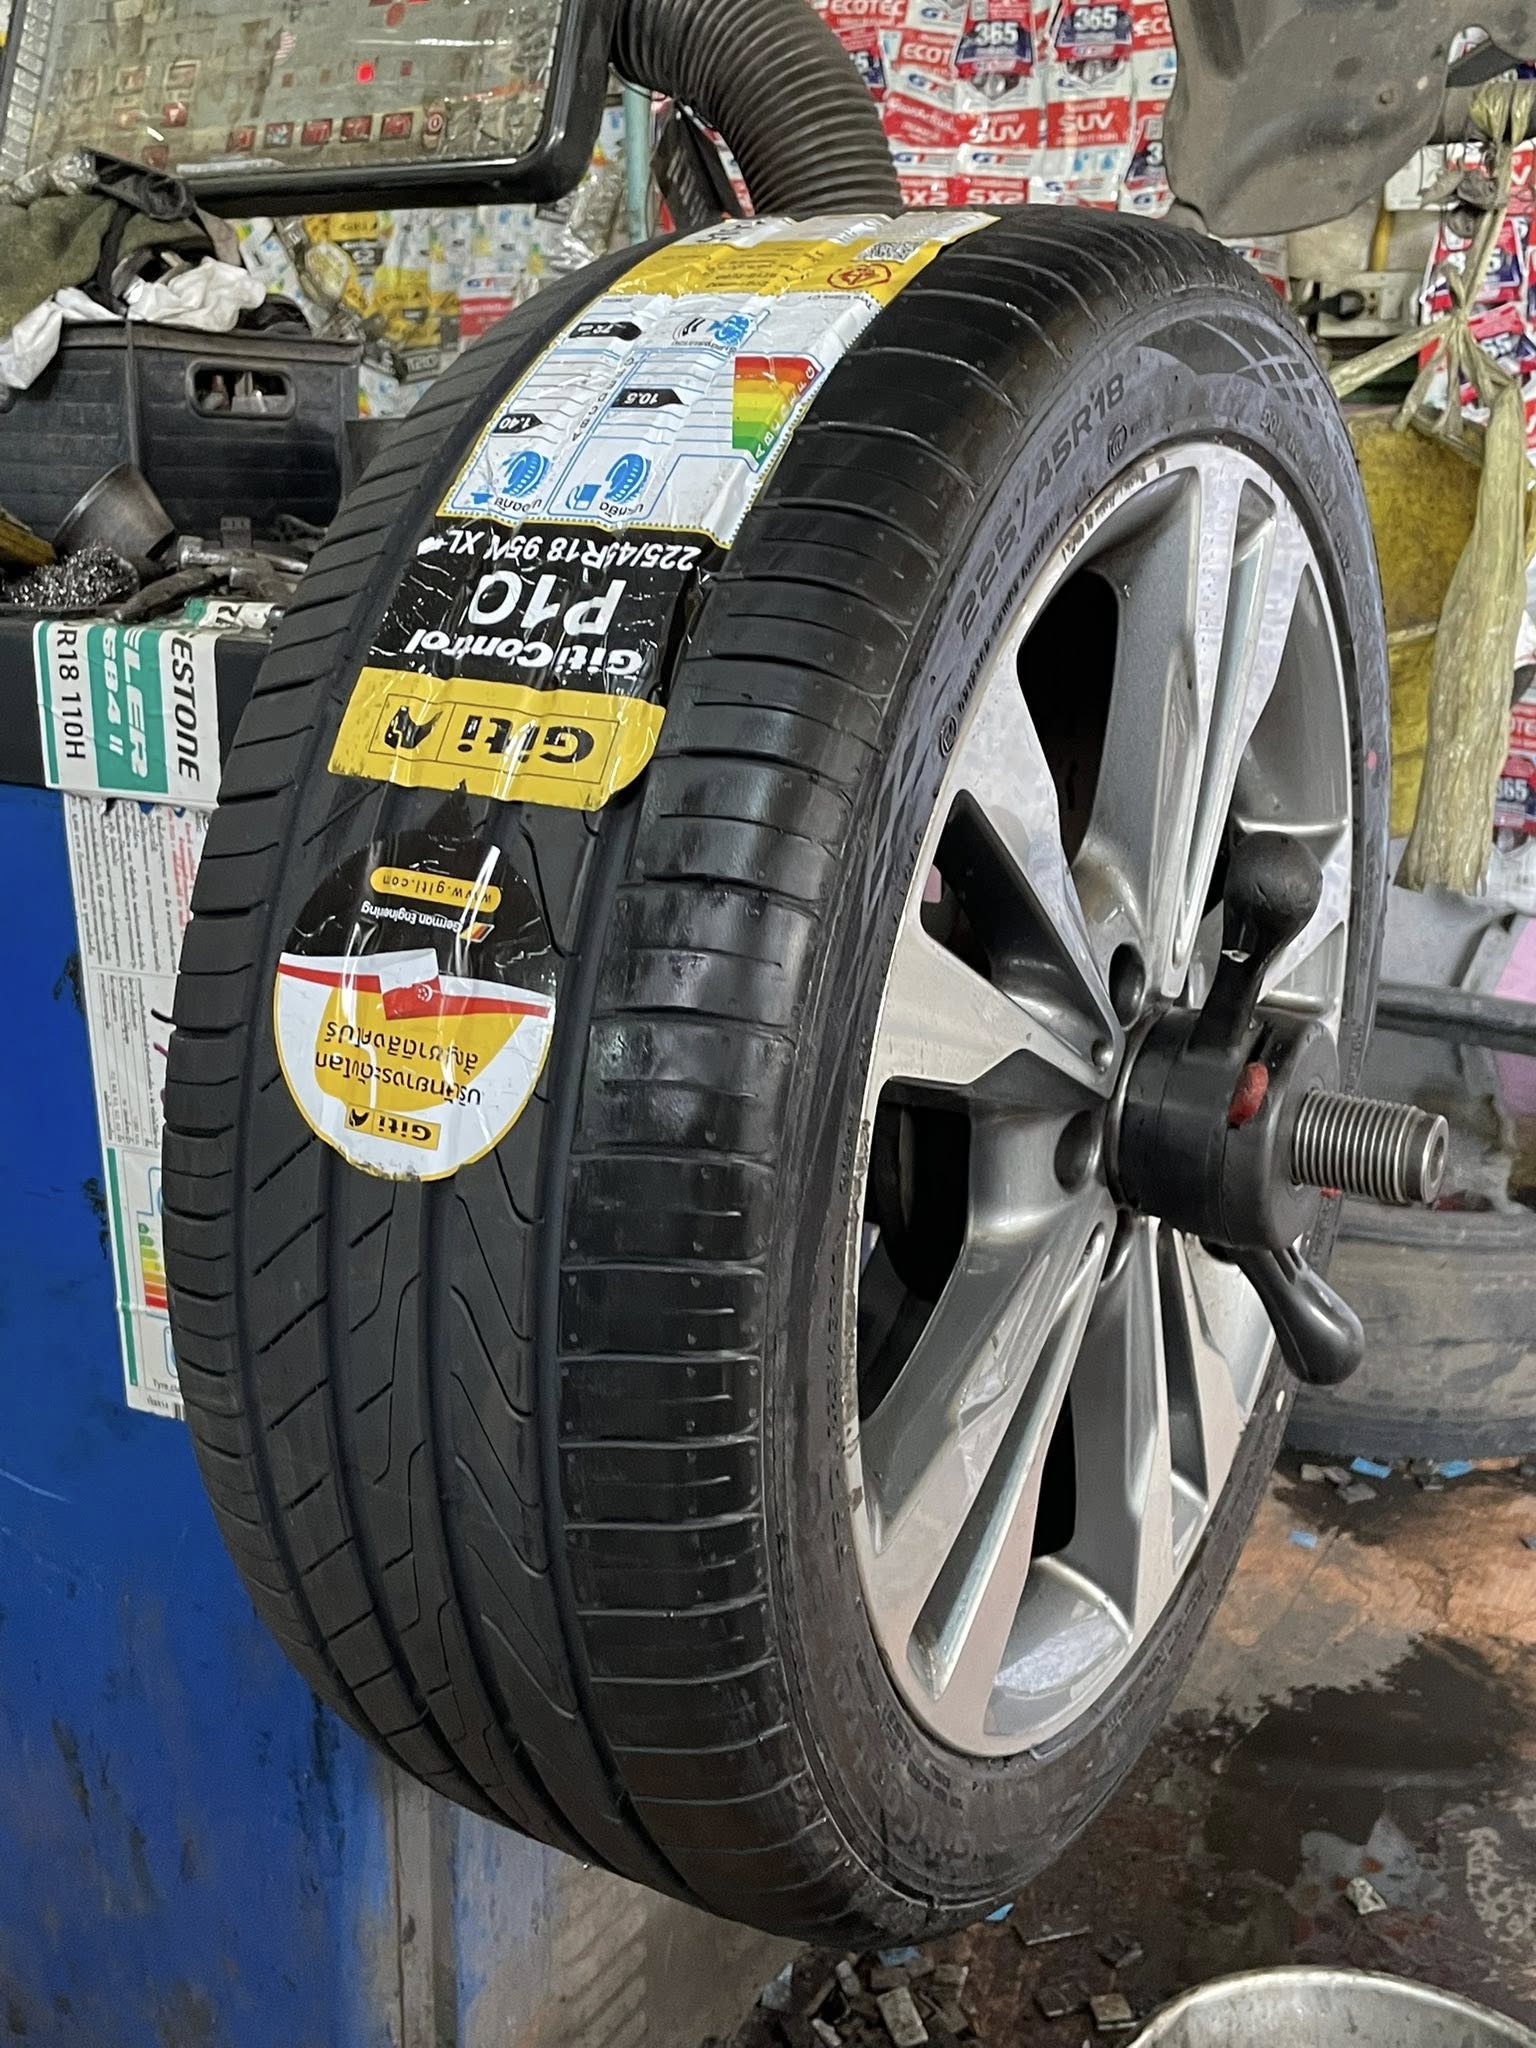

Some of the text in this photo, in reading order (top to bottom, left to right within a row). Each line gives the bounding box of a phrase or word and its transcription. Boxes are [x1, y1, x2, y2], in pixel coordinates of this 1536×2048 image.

[1072, 5, 1119, 31] 365
[973, 21, 1019, 48] 365
[1058, 112, 1114, 134] SUV
[624, 392, 659, 405] 10.5
[498, 415, 532, 430] 1.40
[955, 372, 1126, 640] 225/45R18
[447, 529, 485, 555] XL
[467, 570, 627, 637] P10
[404, 629, 645, 675] GitiControl
[57, 624, 86, 760] R18 110H
[171, 634, 201, 782] ESTONE
[457, 714, 596, 764] Giti
[419, 911, 463, 934] German
[377, 1115, 432, 1141] Giti
